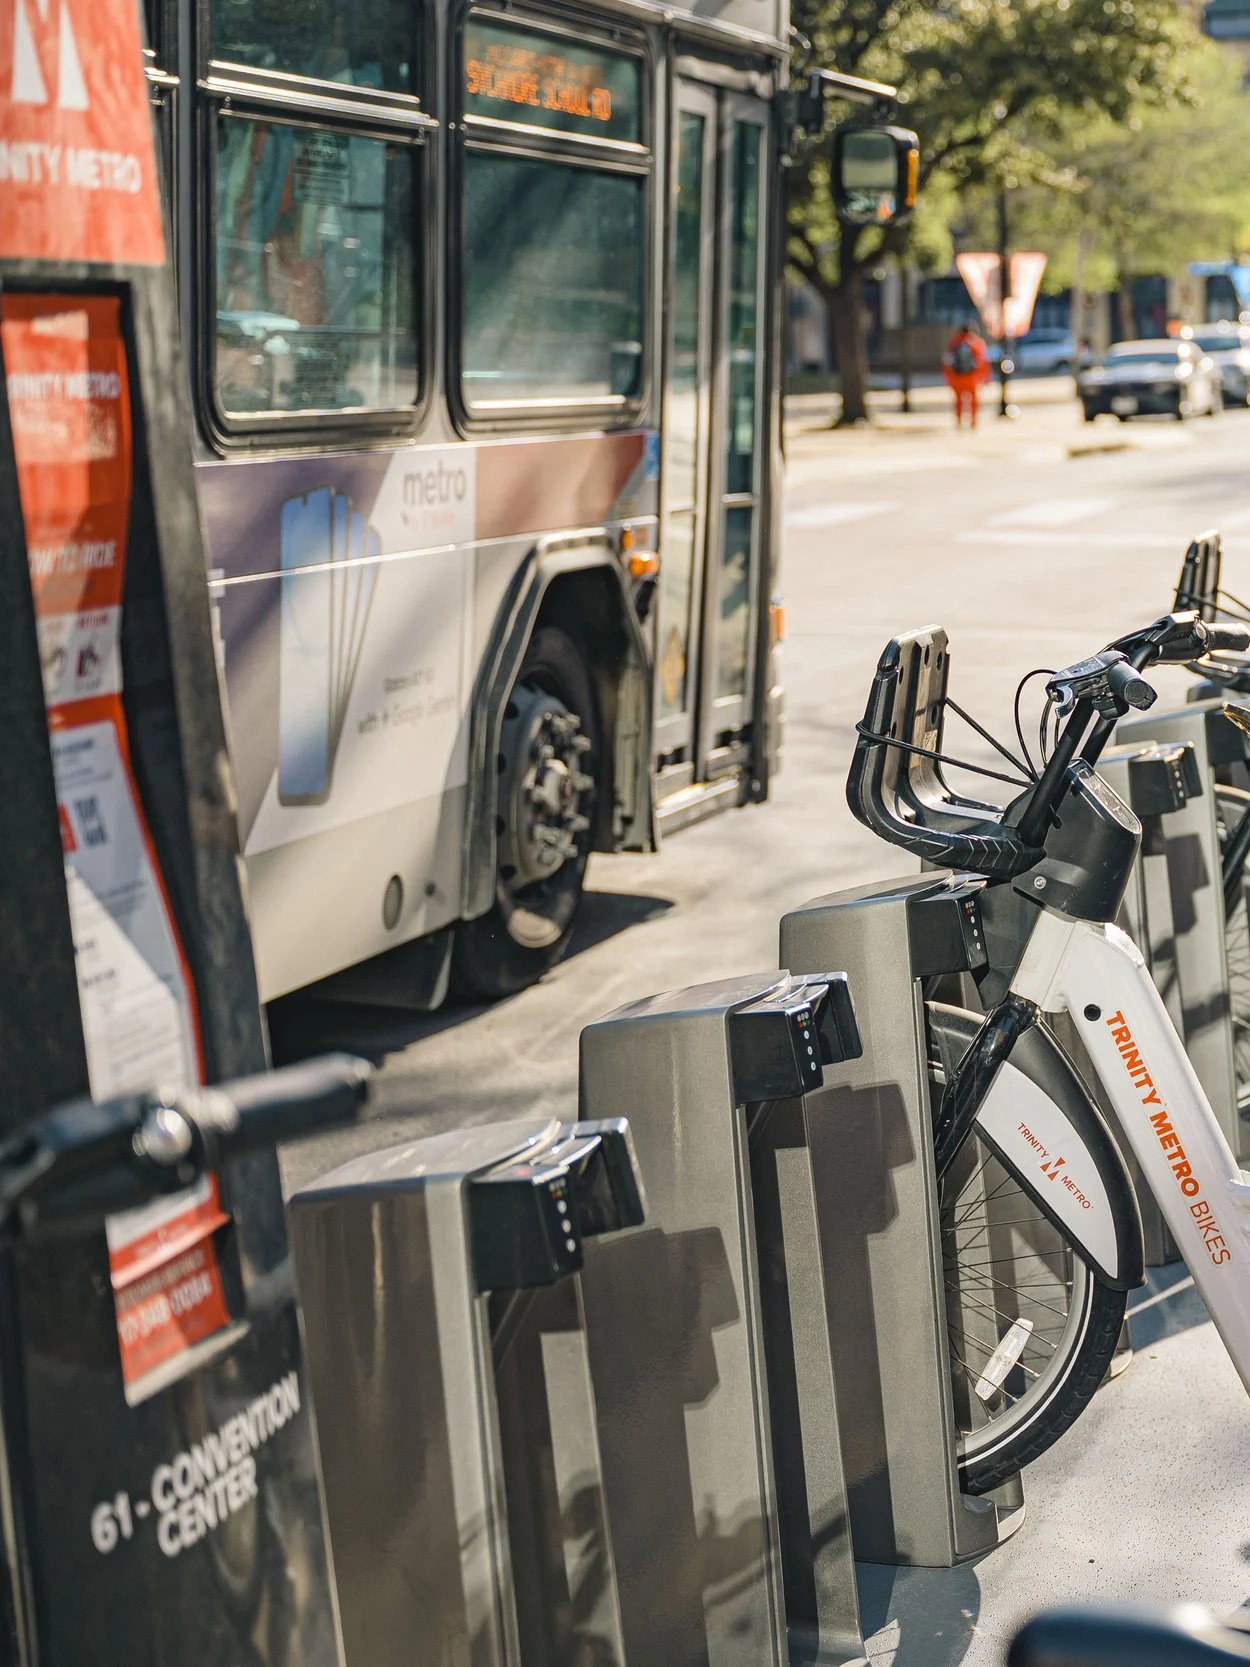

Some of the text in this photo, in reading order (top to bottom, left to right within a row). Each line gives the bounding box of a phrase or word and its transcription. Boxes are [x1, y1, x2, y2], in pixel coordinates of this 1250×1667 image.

[66, 148, 142, 194] METRO
[404, 459, 467, 506] metro
[1017, 1122, 1090, 1209] TRINITY METRO
[1106, 1010, 1231, 1265] TRINITY METRO BIKES
[91, 1490, 133, 1554] 61
[151, 1370, 300, 1514] CONVENTION
[157, 1455, 258, 1558] CENTER
